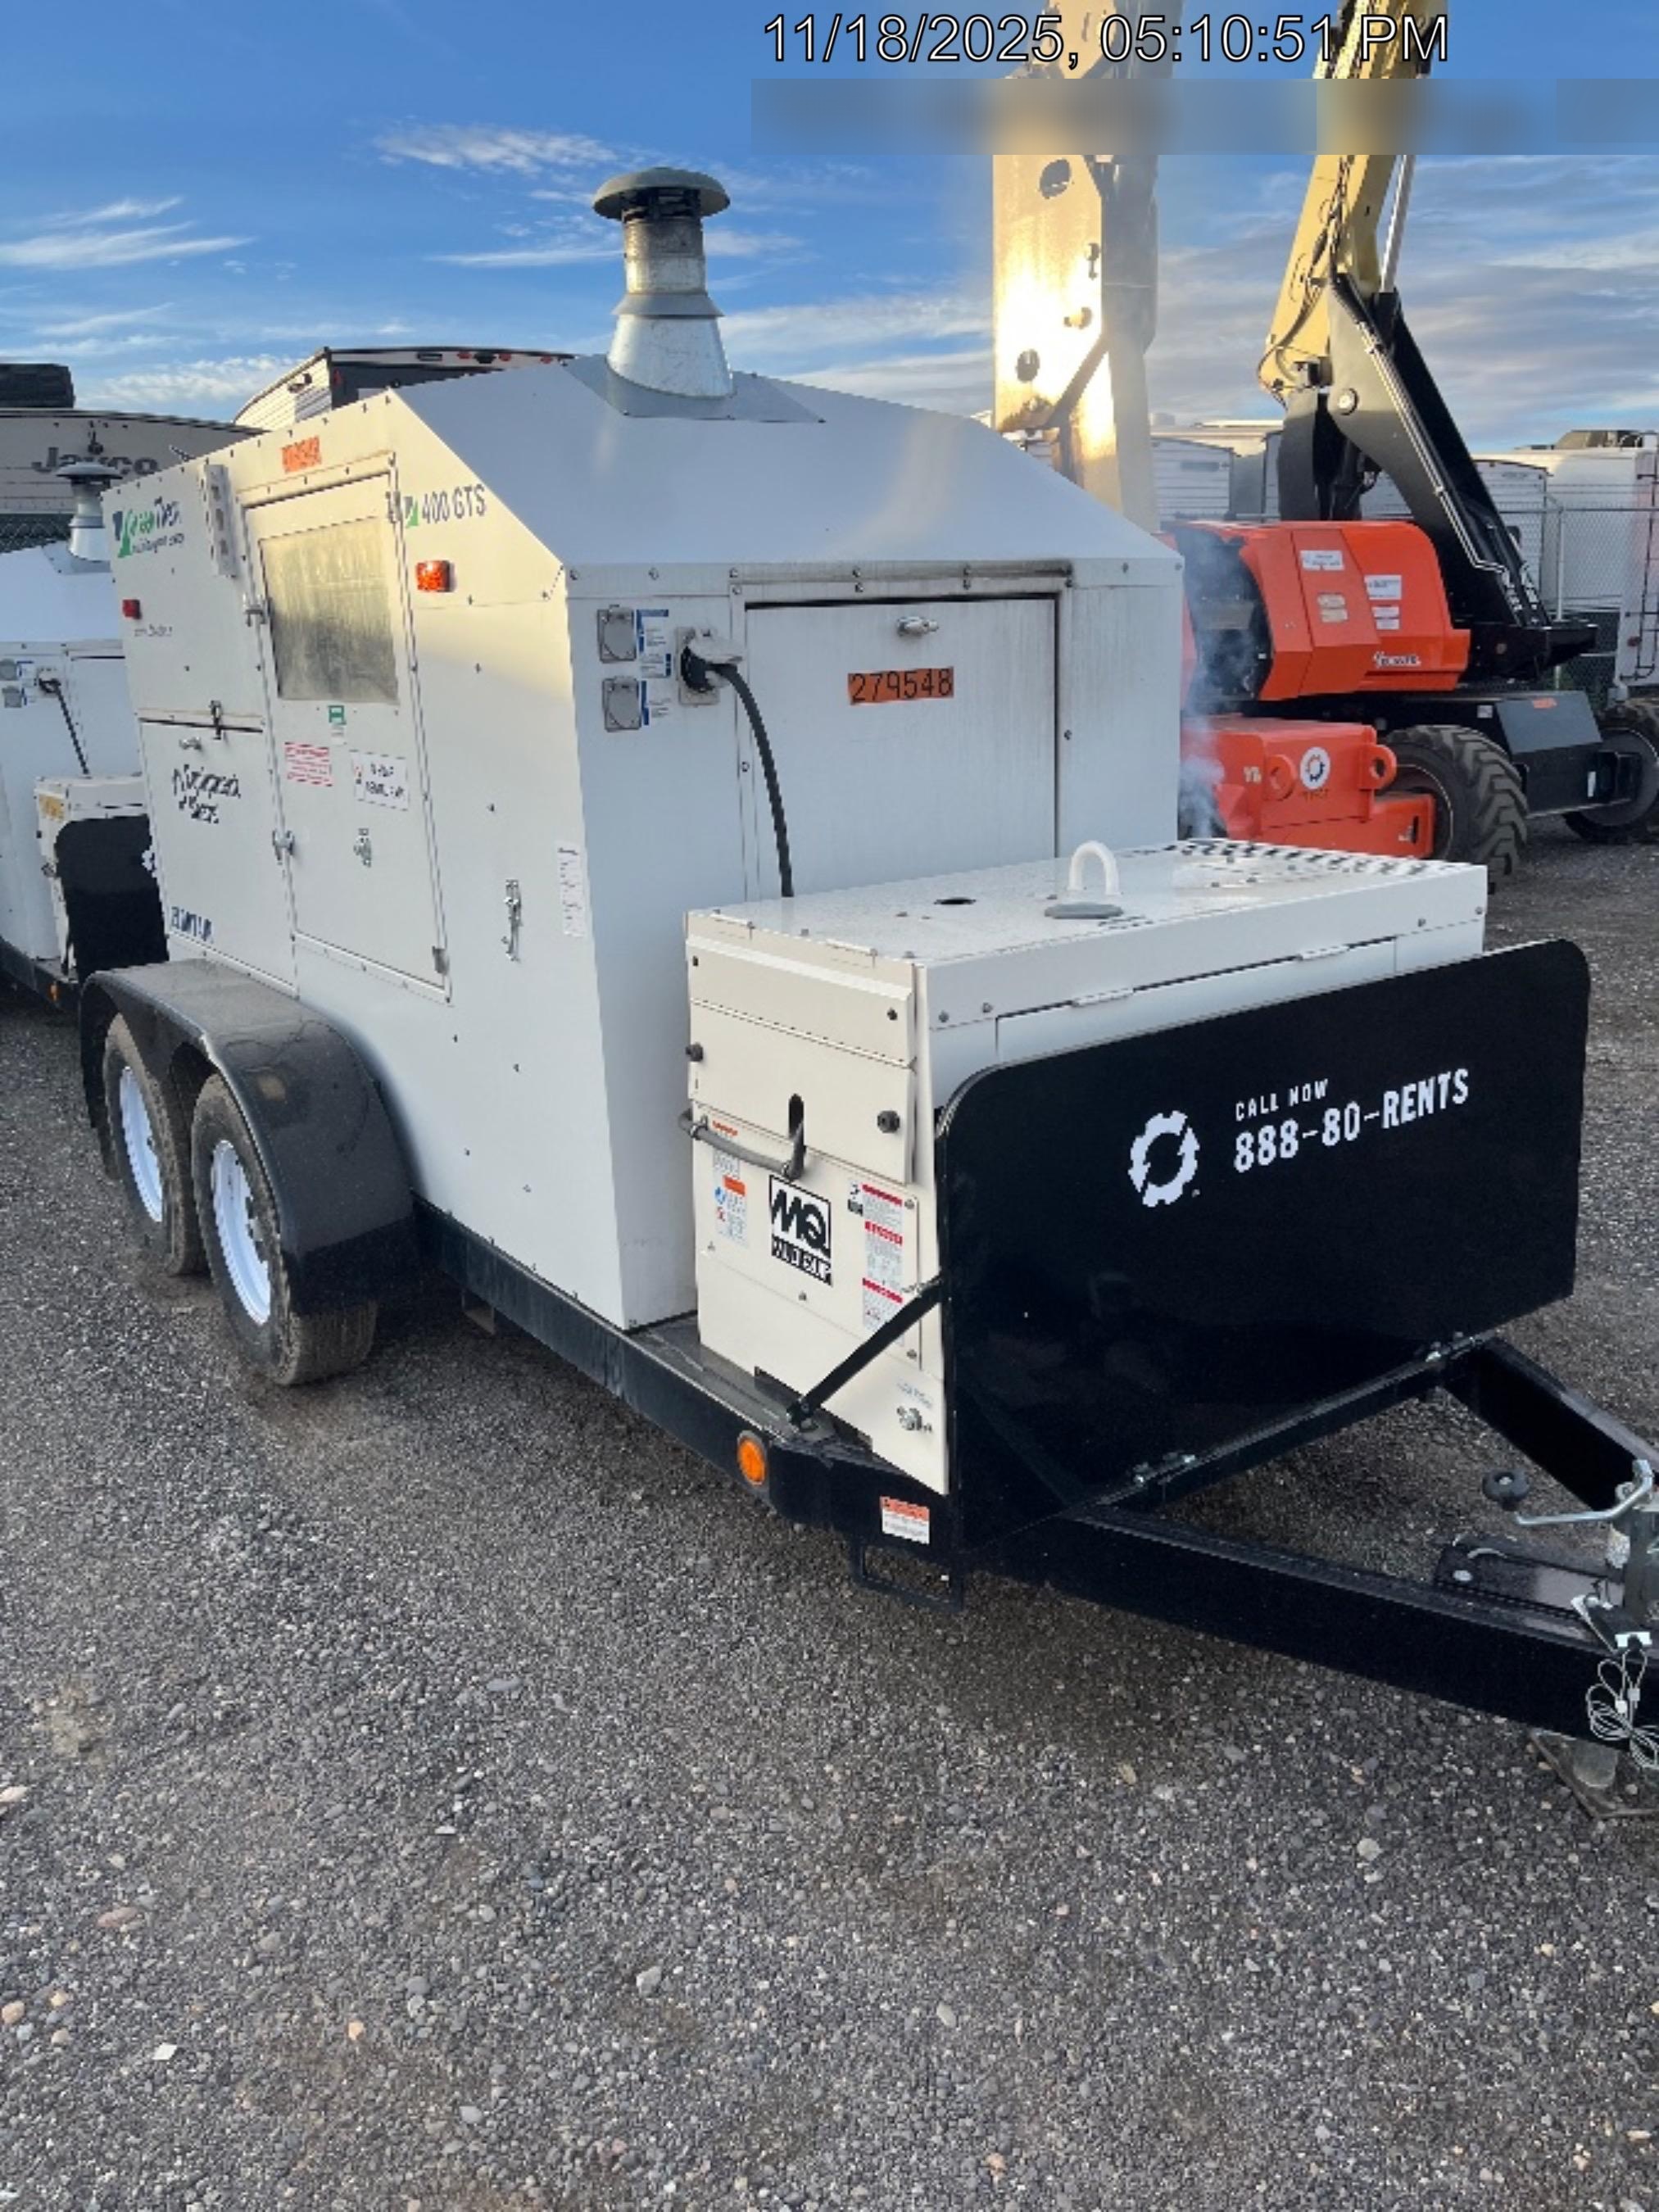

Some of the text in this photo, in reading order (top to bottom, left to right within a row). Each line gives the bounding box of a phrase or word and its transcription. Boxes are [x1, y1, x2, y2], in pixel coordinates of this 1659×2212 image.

[31, 447, 158, 474] Jaco
[422, 483, 485, 524] 400 GTS
[852, 668, 952, 702] 279548
[1234, 1068, 1469, 1173] 888-80-RENTS
[1235, 1078, 1328, 1122] CALL NOW
[771, 1188, 831, 1259] MQ
